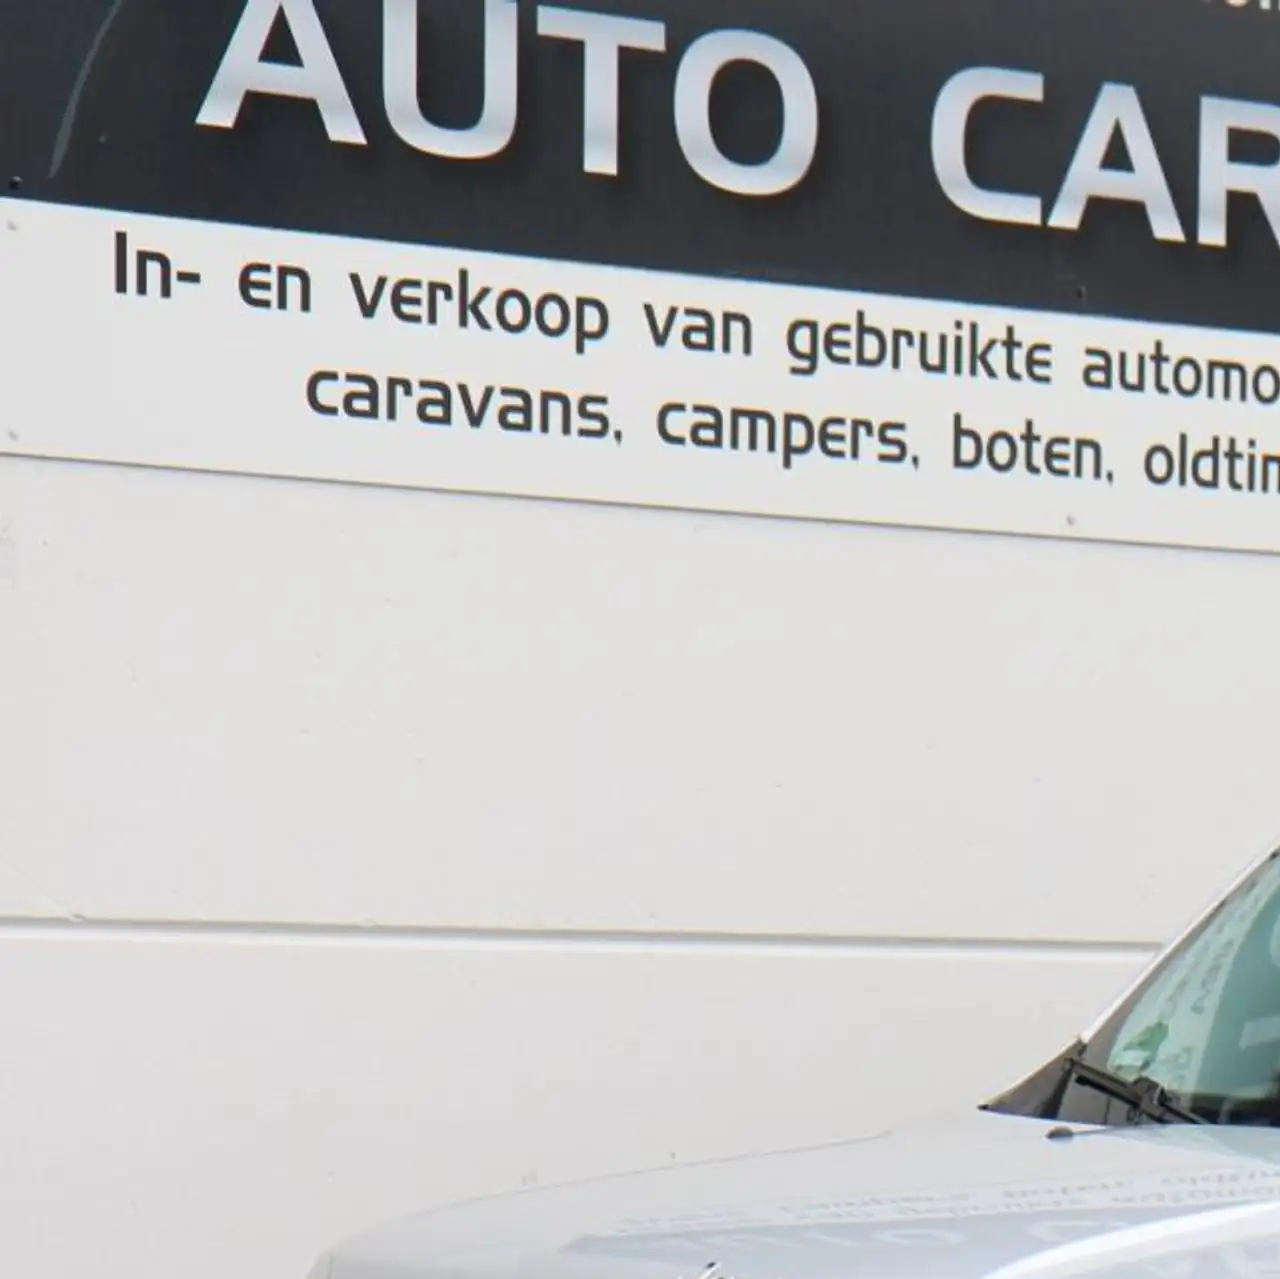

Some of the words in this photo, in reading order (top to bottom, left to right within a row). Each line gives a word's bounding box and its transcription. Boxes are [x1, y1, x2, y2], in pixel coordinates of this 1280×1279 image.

[196, 0, 817, 195] AUTO
[115, 231, 201, 298] In-
[239, 263, 312, 312] en
[349, 270, 608, 354] verkoop
[644, 304, 752, 355] van
[787, 311, 1051, 383] gebruikte
[307, 371, 622, 443] caravans,
[657, 402, 919, 469] campers,
[954, 413, 1114, 485] boten,
